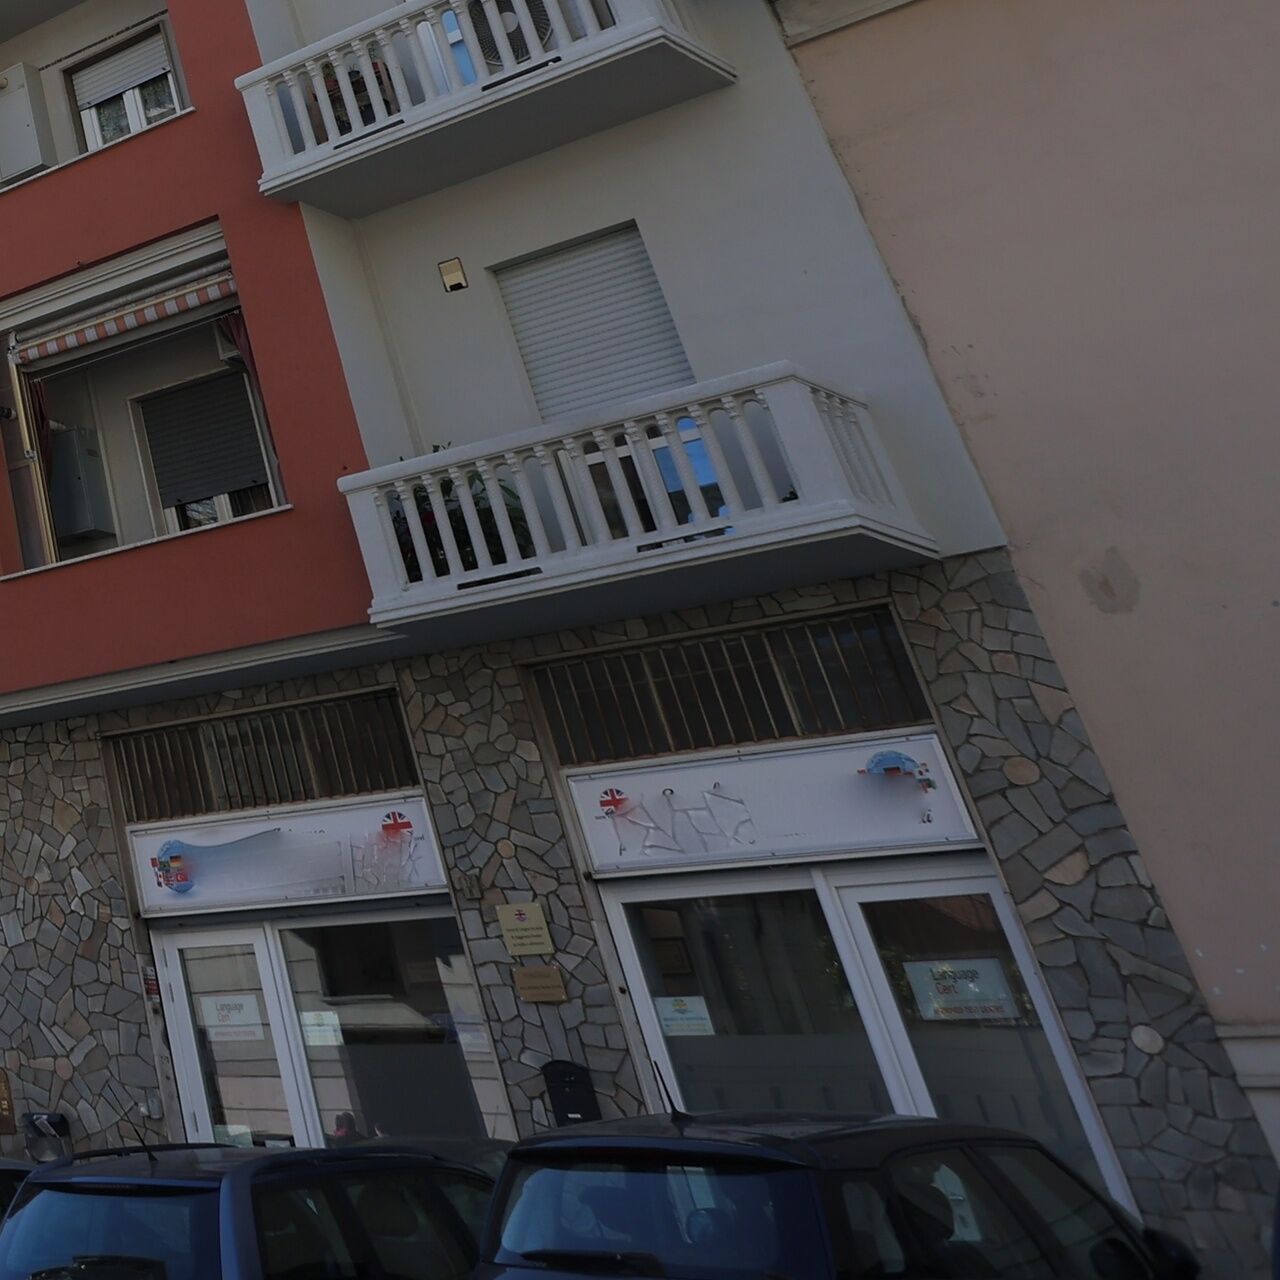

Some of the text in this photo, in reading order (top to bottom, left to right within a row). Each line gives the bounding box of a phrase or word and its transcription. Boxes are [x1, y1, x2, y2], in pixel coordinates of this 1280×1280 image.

[929, 967, 980, 983] Language
[935, 982, 959, 994] Cert
[215, 1001, 244, 1014] Language
